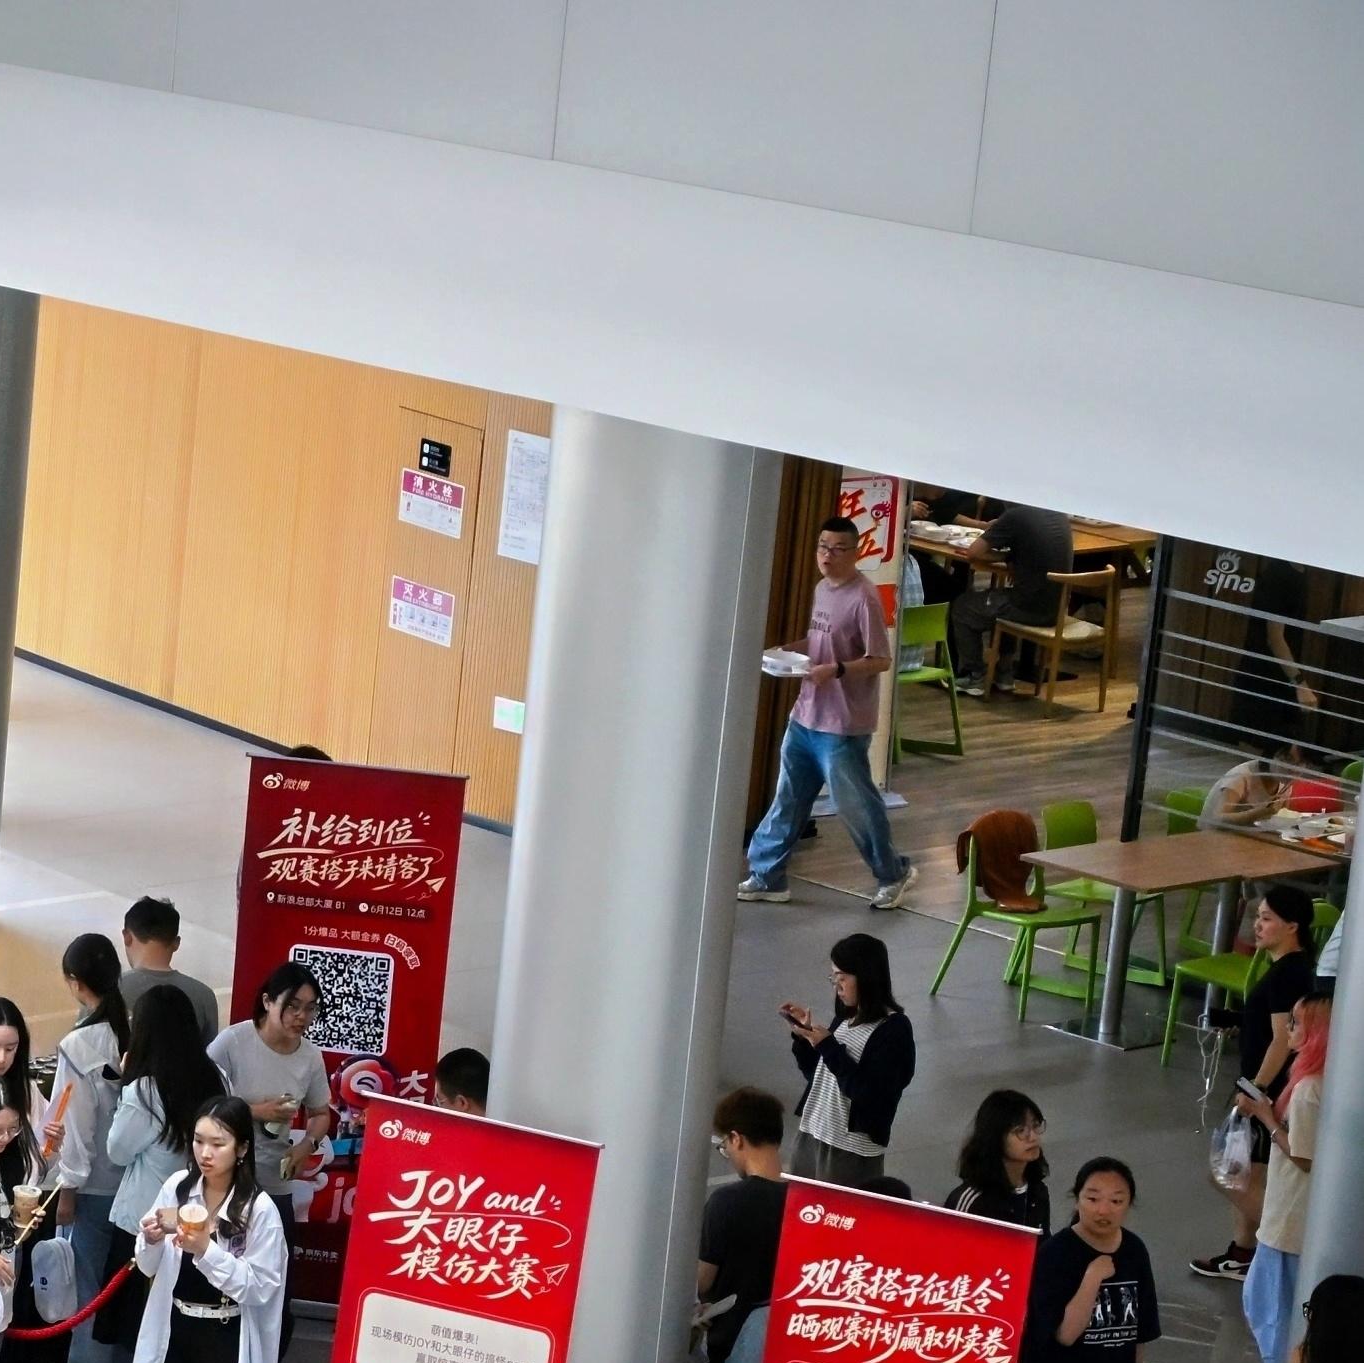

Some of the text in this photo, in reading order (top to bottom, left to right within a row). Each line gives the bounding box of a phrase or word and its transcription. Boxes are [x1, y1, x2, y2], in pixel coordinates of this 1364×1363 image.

[283, 776, 311, 791] 微博
[265, 808, 426, 848] 补给到位
[260, 854, 434, 890] 观赛搭子来请客了
[277, 894, 333, 909] 新浪总部大厦
[371, 905, 403, 916] 6月12日
[401, 1128, 432, 1146] 微博
[388, 1170, 547, 1216] JOY and
[383, 1208, 529, 1255] 大眼仔
[823, 1212, 857, 1231] 微博
[387, 1244, 541, 1300] 模仿大赛
[778, 1255, 1004, 1314] 观赛搭子征集令
